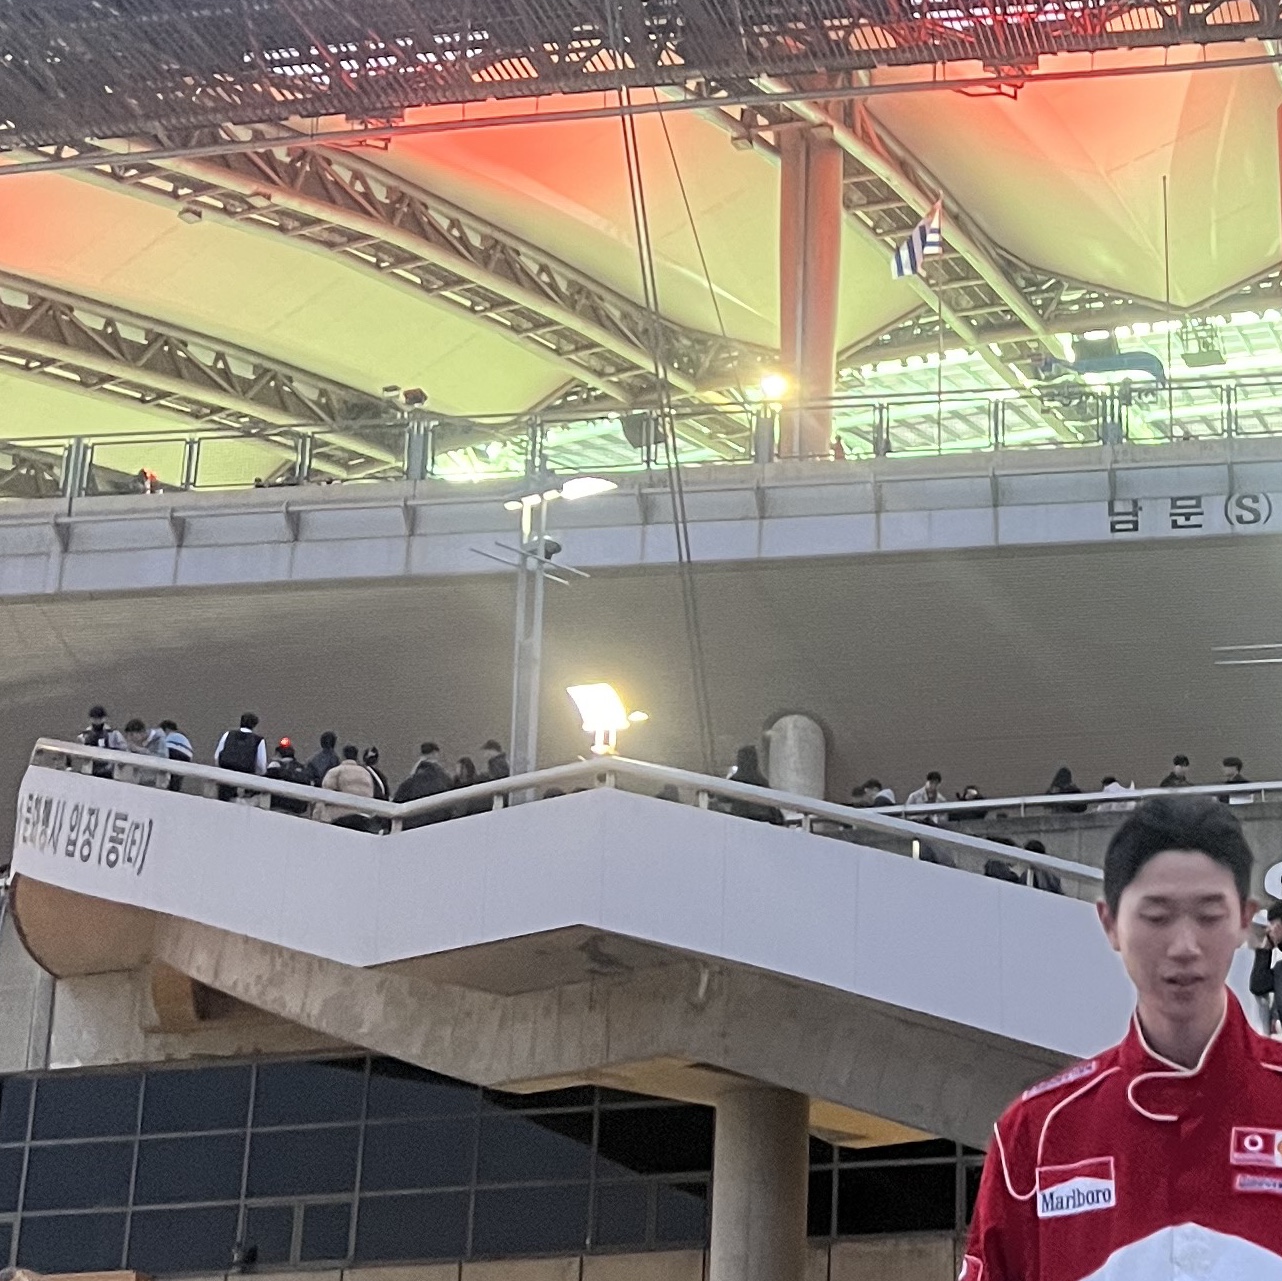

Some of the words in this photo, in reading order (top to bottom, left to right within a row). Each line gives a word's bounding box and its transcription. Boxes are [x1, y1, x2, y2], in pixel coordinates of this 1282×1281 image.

[1223, 491, 1272, 526] (S)
[65, 804, 100, 862] 입장
[1041, 1188, 1112, 1214] Marlboro
